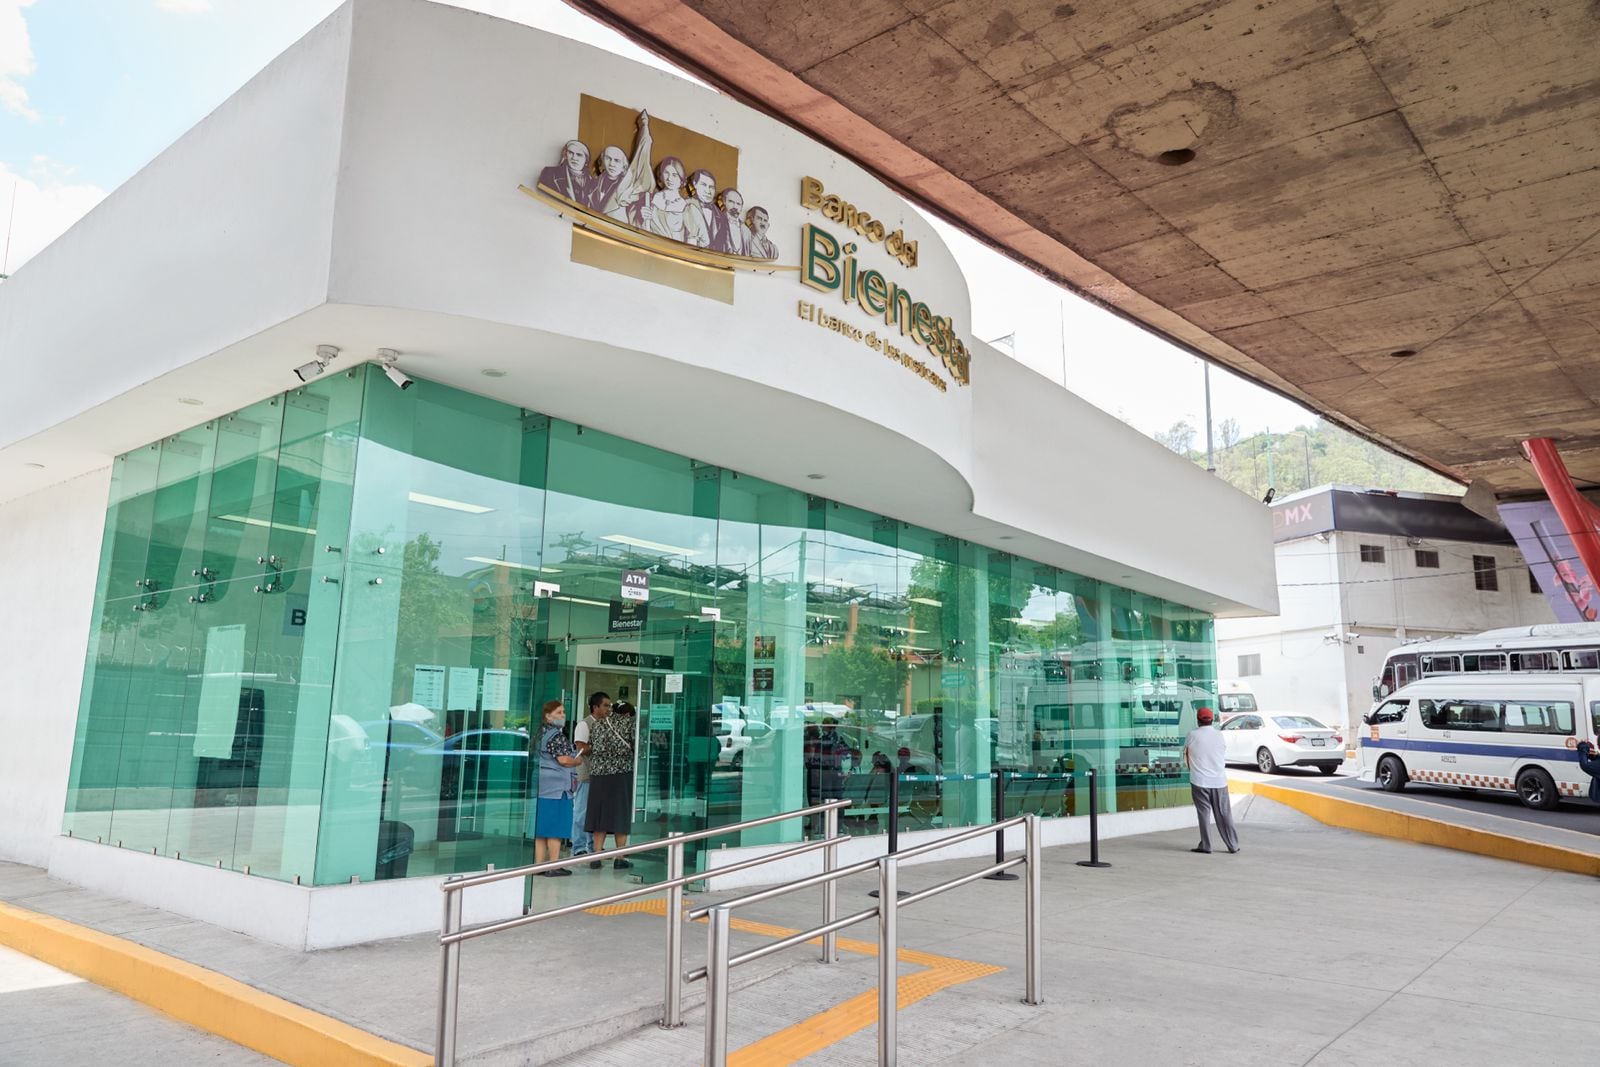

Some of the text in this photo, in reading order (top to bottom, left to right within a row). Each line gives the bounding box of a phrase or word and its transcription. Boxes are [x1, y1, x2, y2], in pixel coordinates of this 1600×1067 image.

[800, 176, 918, 268] Banco del
[800, 223, 971, 386] Bienestar
[797, 300, 815, 322] El
[818, 308, 862, 342] banco
[865, 331, 882, 351] de
[625, 574, 647, 586] ATM
[612, 619, 643, 629] Bienestar
[616, 653, 661, 666] CAJA 2
